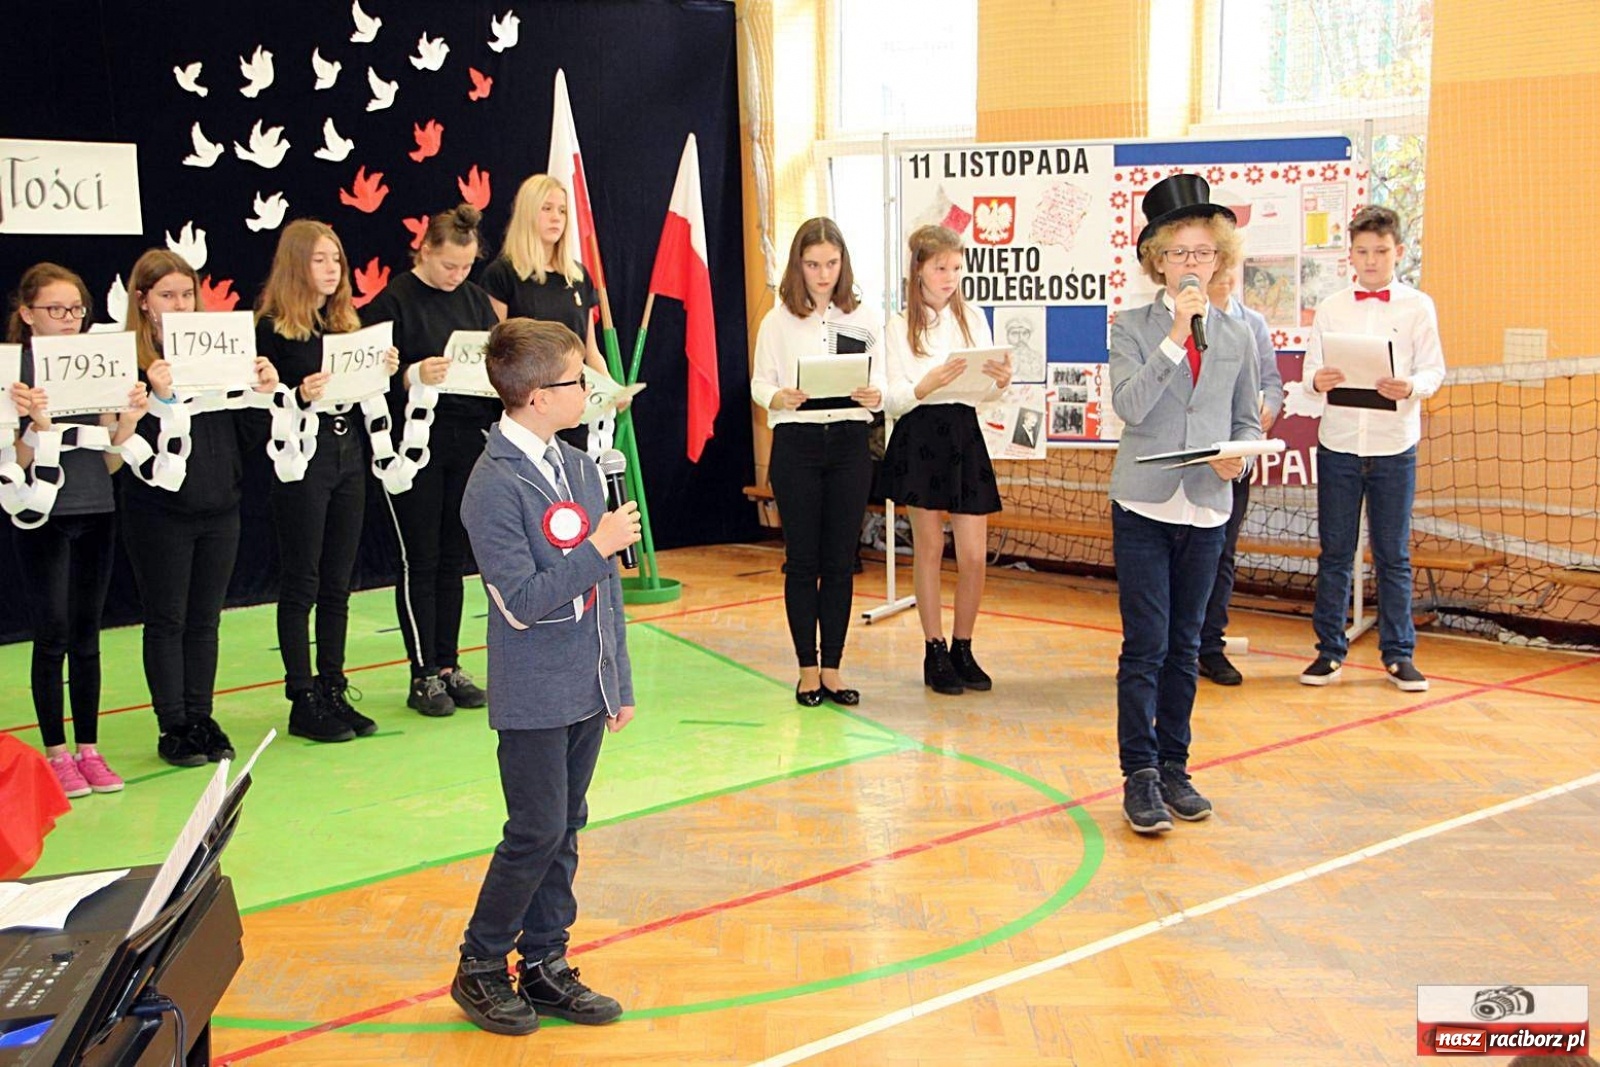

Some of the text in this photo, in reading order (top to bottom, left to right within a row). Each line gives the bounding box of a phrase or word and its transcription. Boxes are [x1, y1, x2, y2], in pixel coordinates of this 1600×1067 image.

[909, 147, 1089, 179] 11 LISTOPADA
[0, 156, 109, 224] łości
[964, 246, 1040, 276] WIĘTO
[962, 266, 1106, 301] ODLEGŁOŚCI
[171, 330, 245, 356] 1794r.
[452, 343, 482, 364] 183
[43, 353, 126, 382] 1793r.
